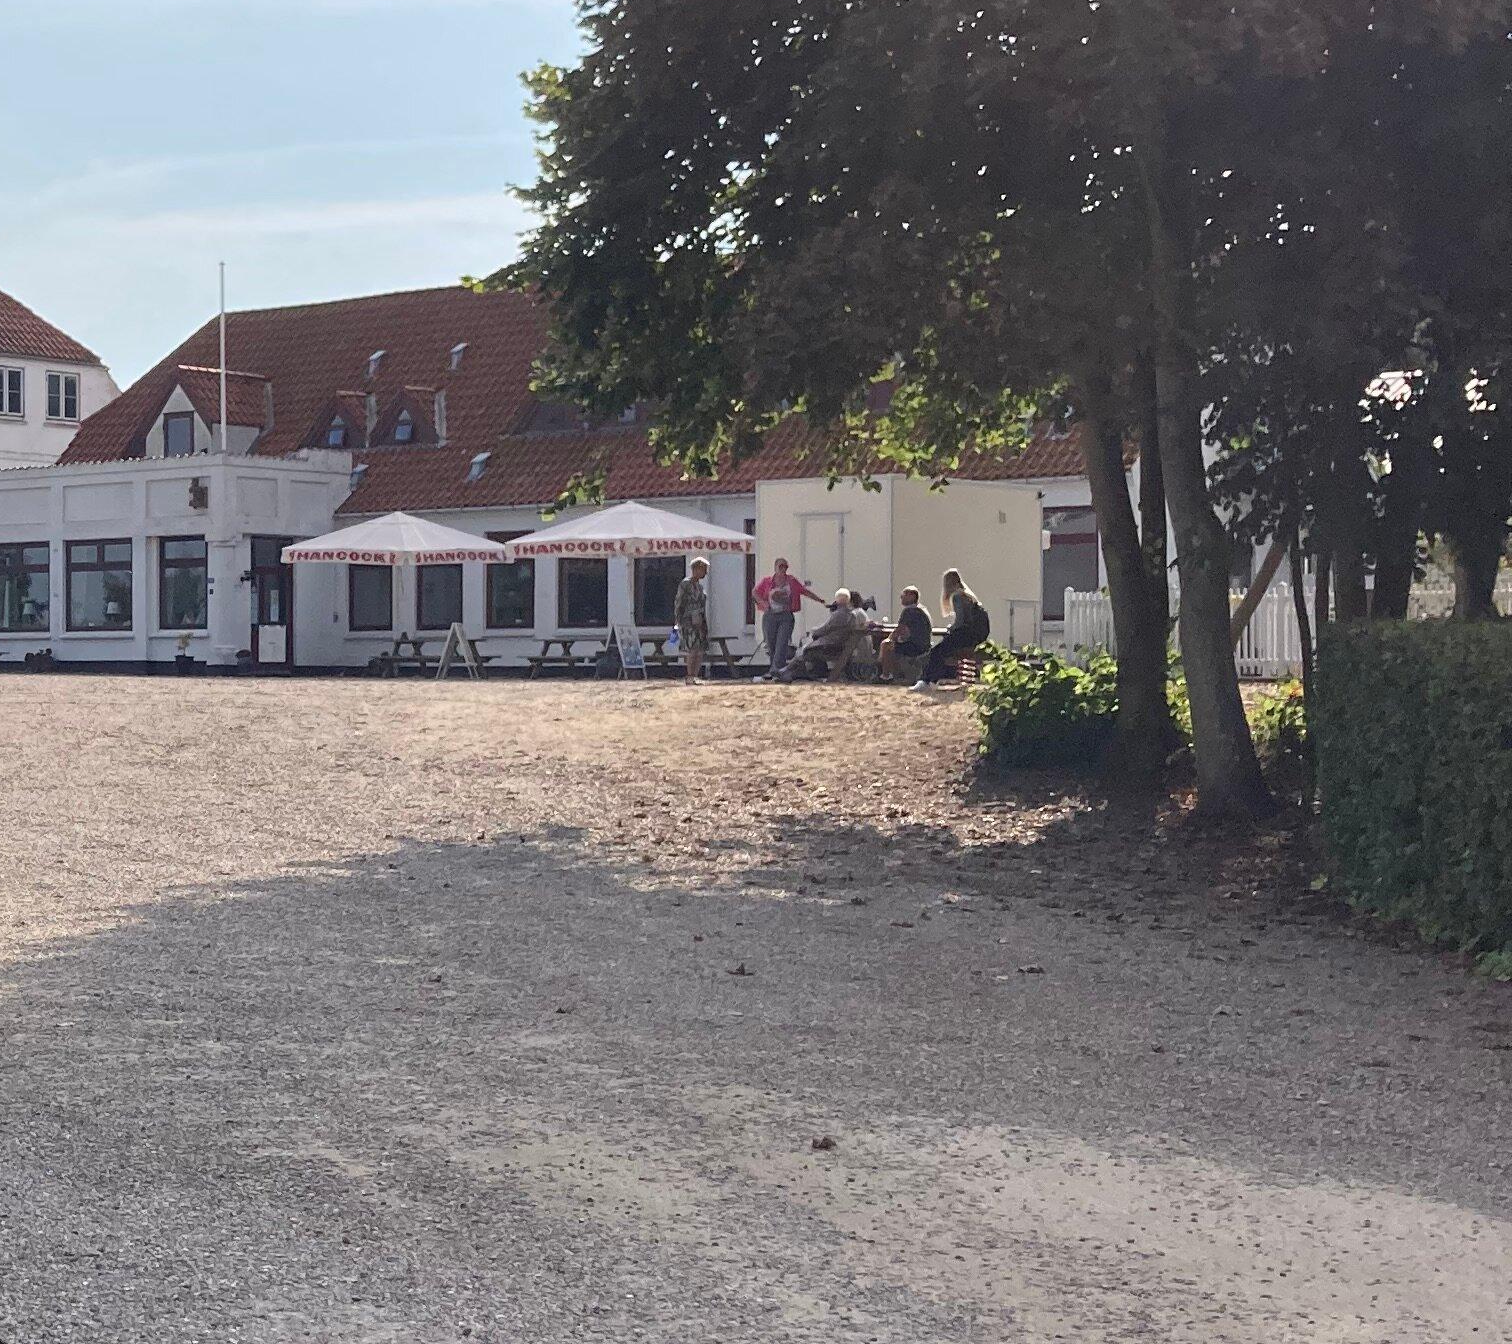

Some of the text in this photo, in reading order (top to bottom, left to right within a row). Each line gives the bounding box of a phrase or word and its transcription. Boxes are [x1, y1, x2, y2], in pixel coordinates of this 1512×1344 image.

[522, 541, 617, 555] HANCOCK
[655, 539, 745, 553] HANCOCK
[296, 551, 386, 563] HANCOCK
